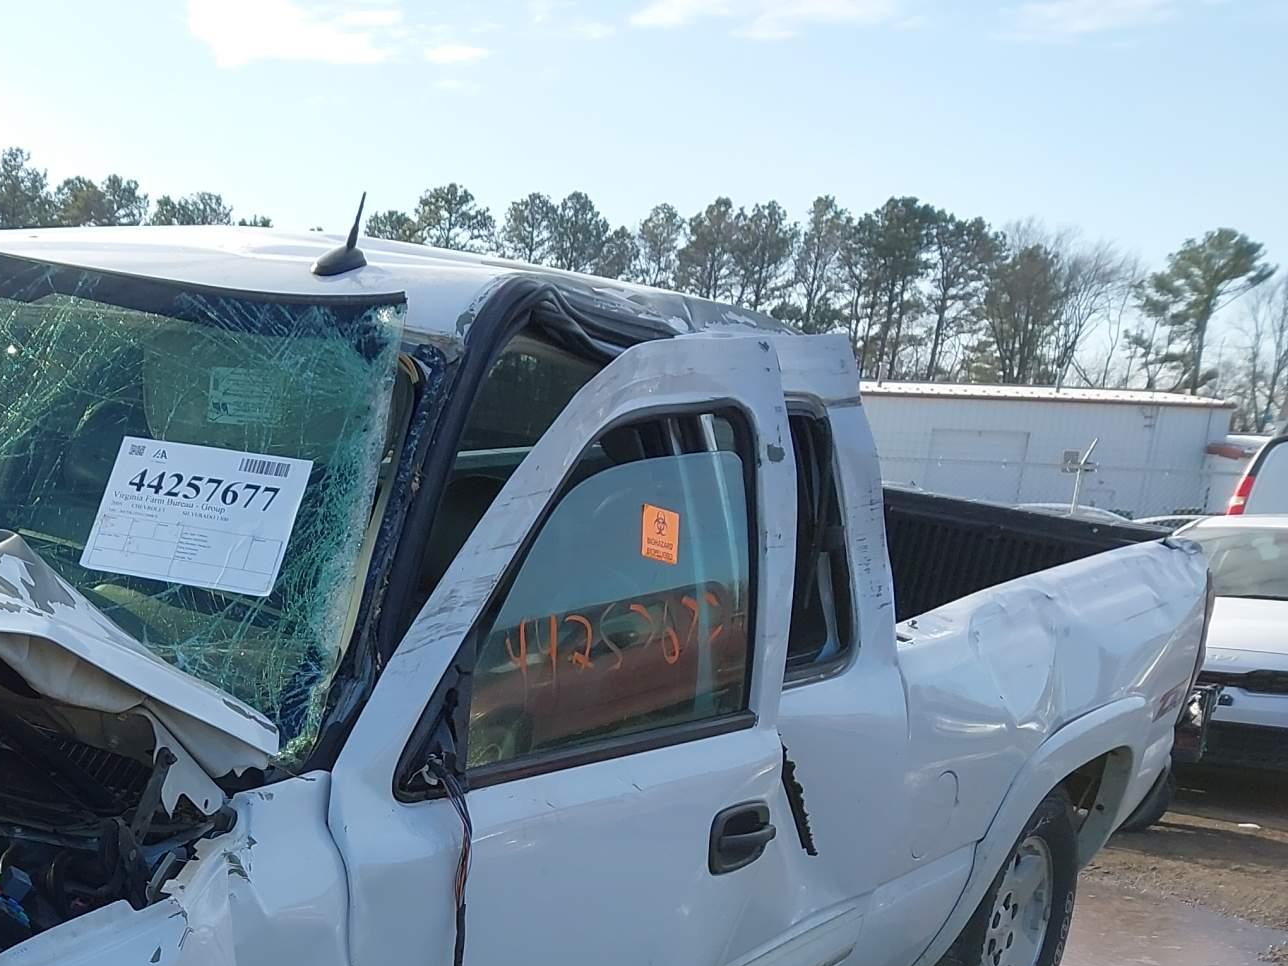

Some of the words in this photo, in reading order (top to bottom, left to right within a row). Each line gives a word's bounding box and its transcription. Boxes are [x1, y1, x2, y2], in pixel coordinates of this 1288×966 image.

[114, 491, 143, 502] Virginia
[145, 496, 165, 504] Farm
[167, 498, 193, 508] Bureau
[201, 502, 226, 514] Group
[129, 468, 280, 511] 44257677
